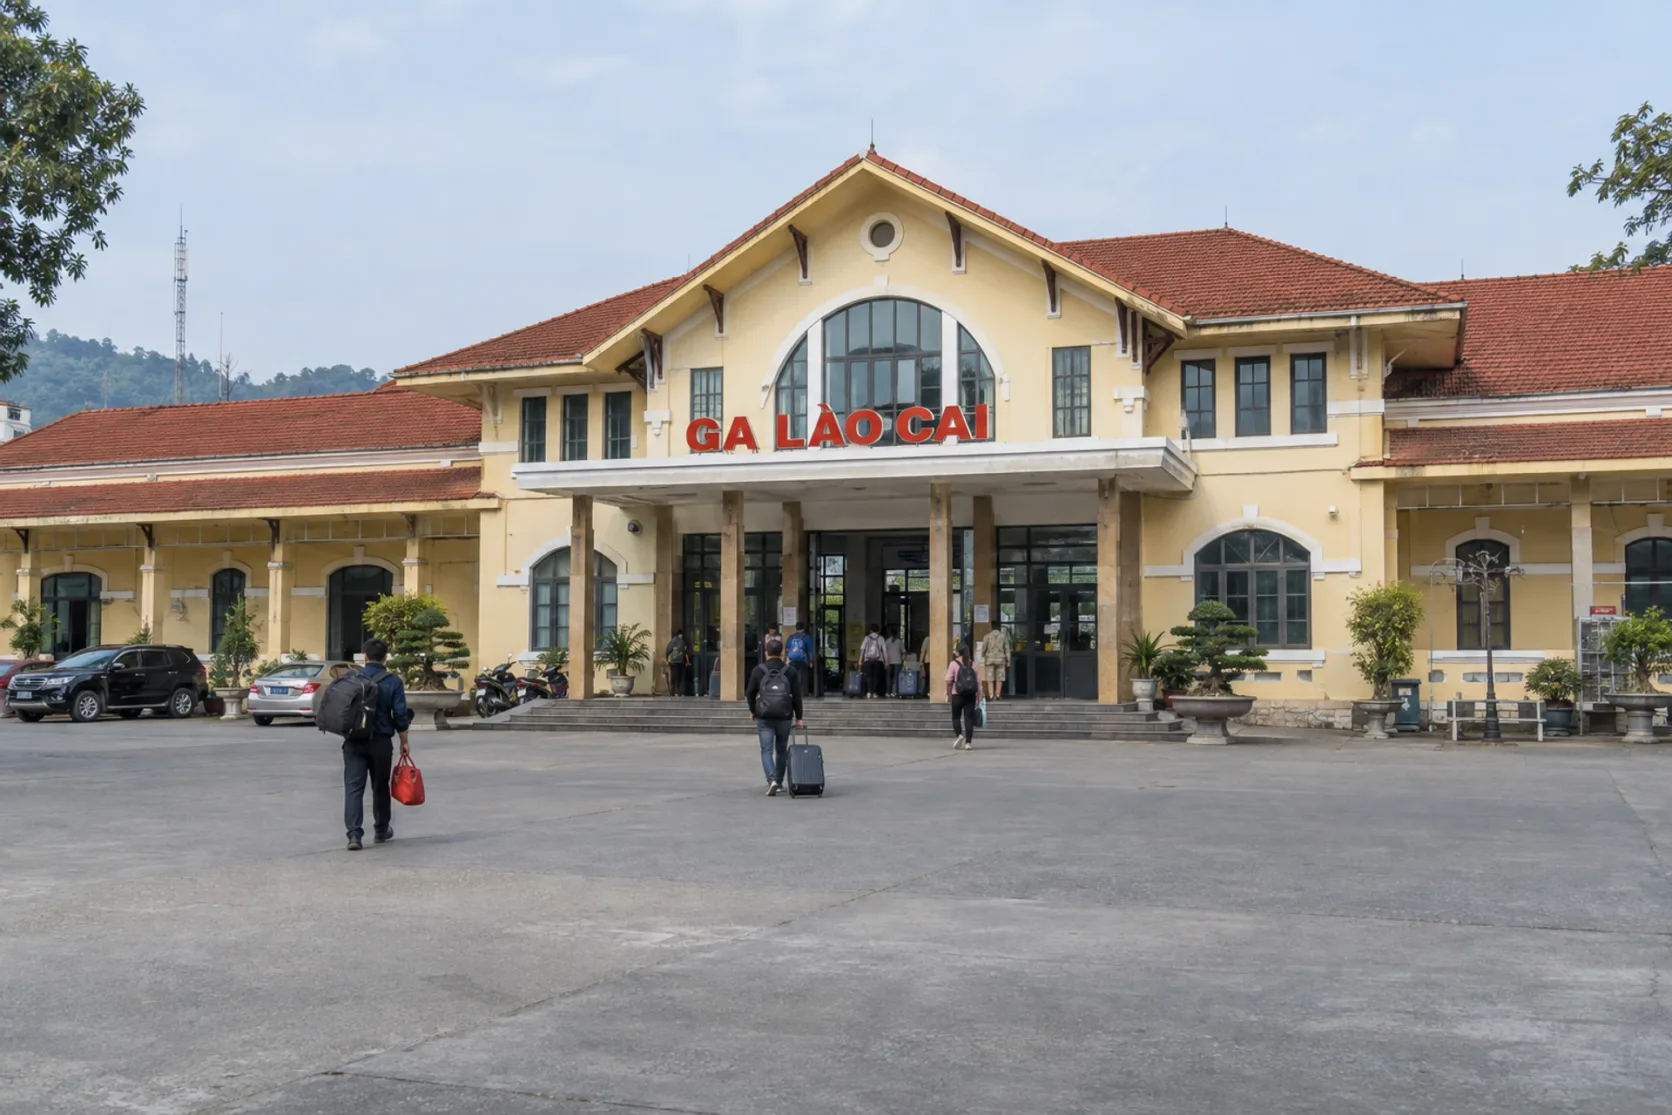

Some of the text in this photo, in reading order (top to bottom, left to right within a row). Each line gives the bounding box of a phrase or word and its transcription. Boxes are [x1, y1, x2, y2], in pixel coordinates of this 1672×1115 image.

[686, 403, 989, 452] GA LÀO CAI
